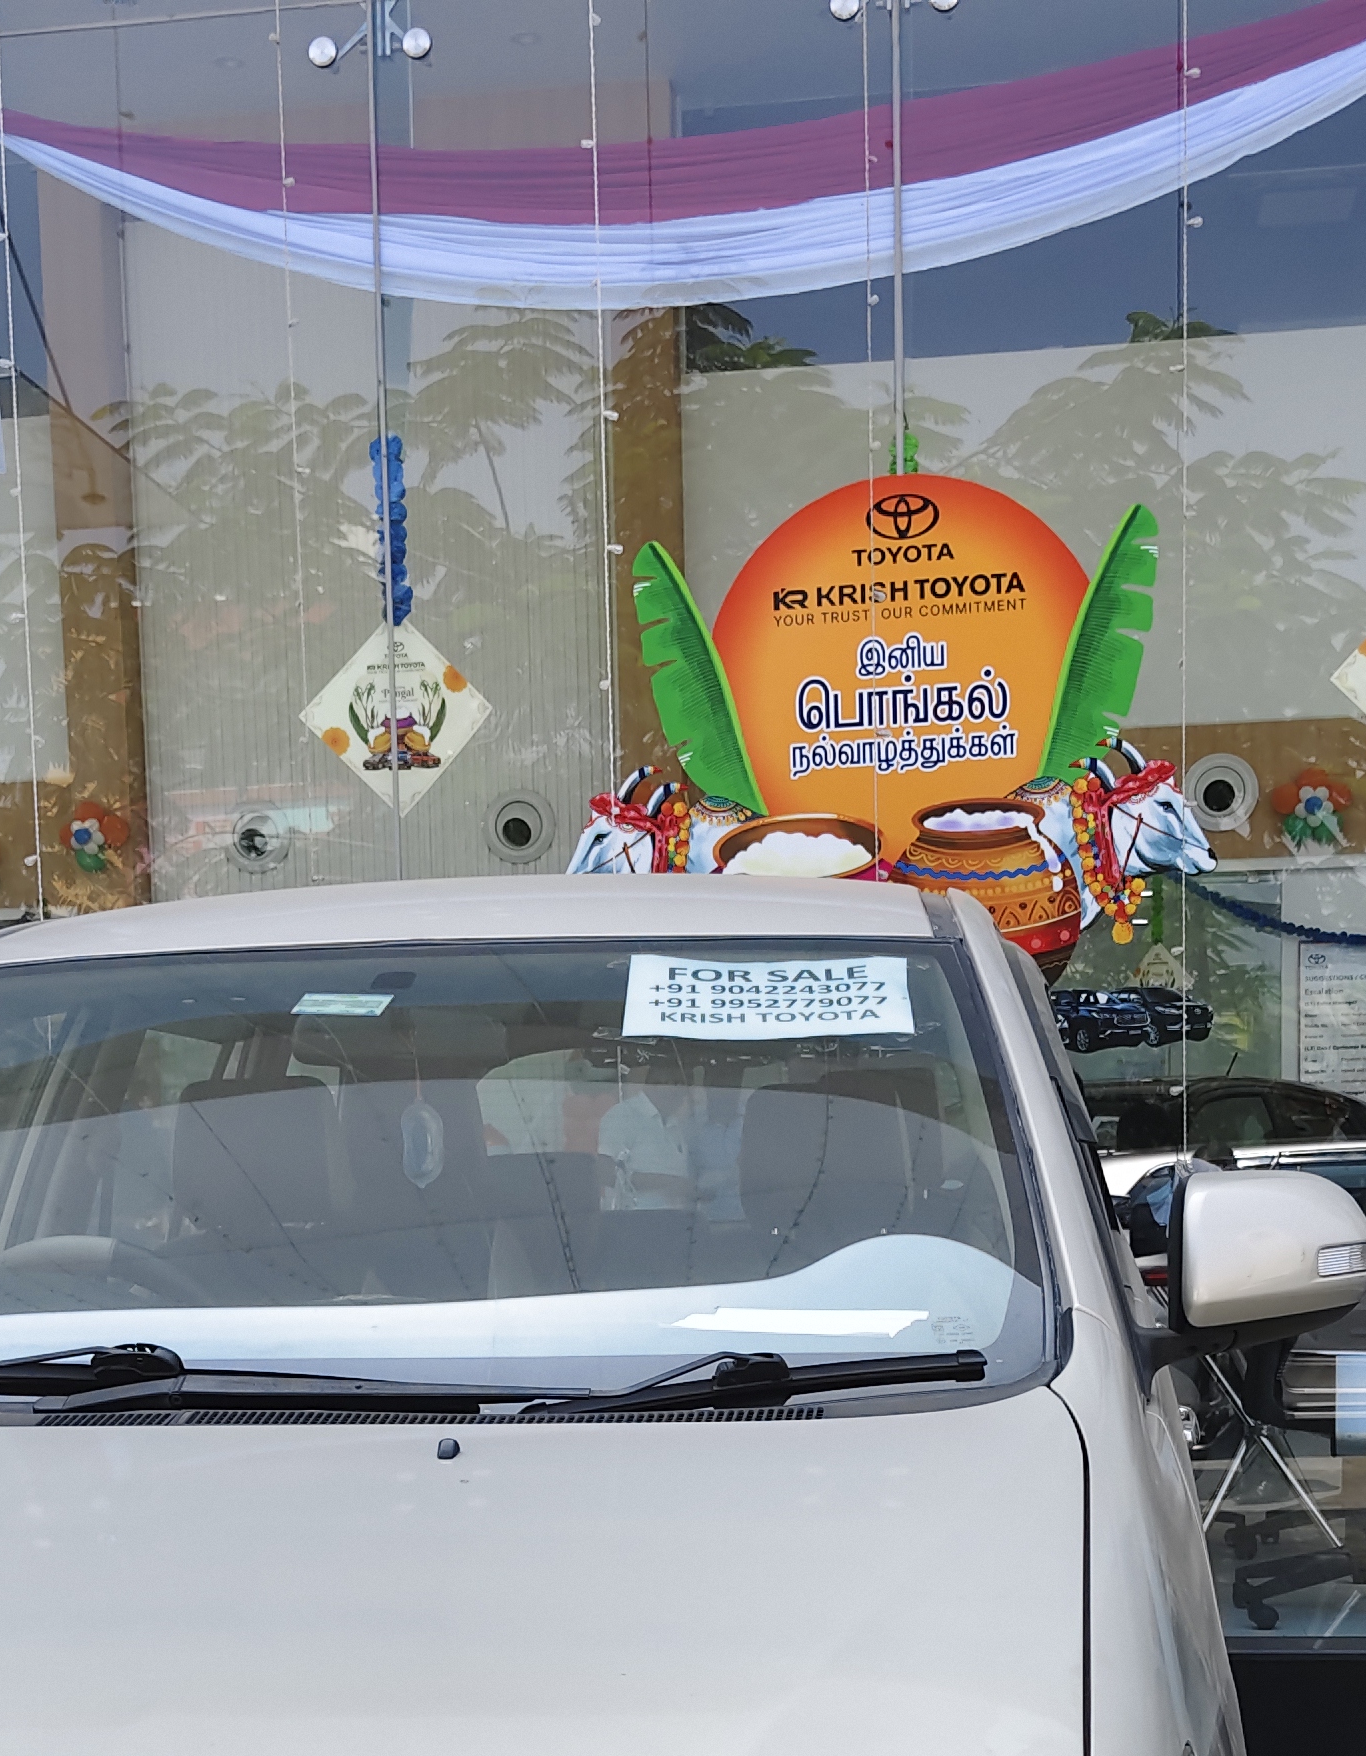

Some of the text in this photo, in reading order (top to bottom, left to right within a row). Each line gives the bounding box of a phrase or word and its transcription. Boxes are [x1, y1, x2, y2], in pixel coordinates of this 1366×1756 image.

[852, 543, 955, 567] TOYOTA
[773, 572, 1026, 611] KR KRISH TOYOTA
[773, 598, 1027, 627] YOUR TRUST OUR COMMITMENT
[858, 634, 946, 676] இனிய
[381, 686, 415, 699] Pngal
[797, 669, 1009, 730] பொங்கல்
[668, 965, 869, 983] FOR SALE
[649, 981, 887, 996] +91 9042243077
[648, 996, 888, 1009] +91 9952779077
[660, 1009, 881, 1024] KRISH TOYOTA
